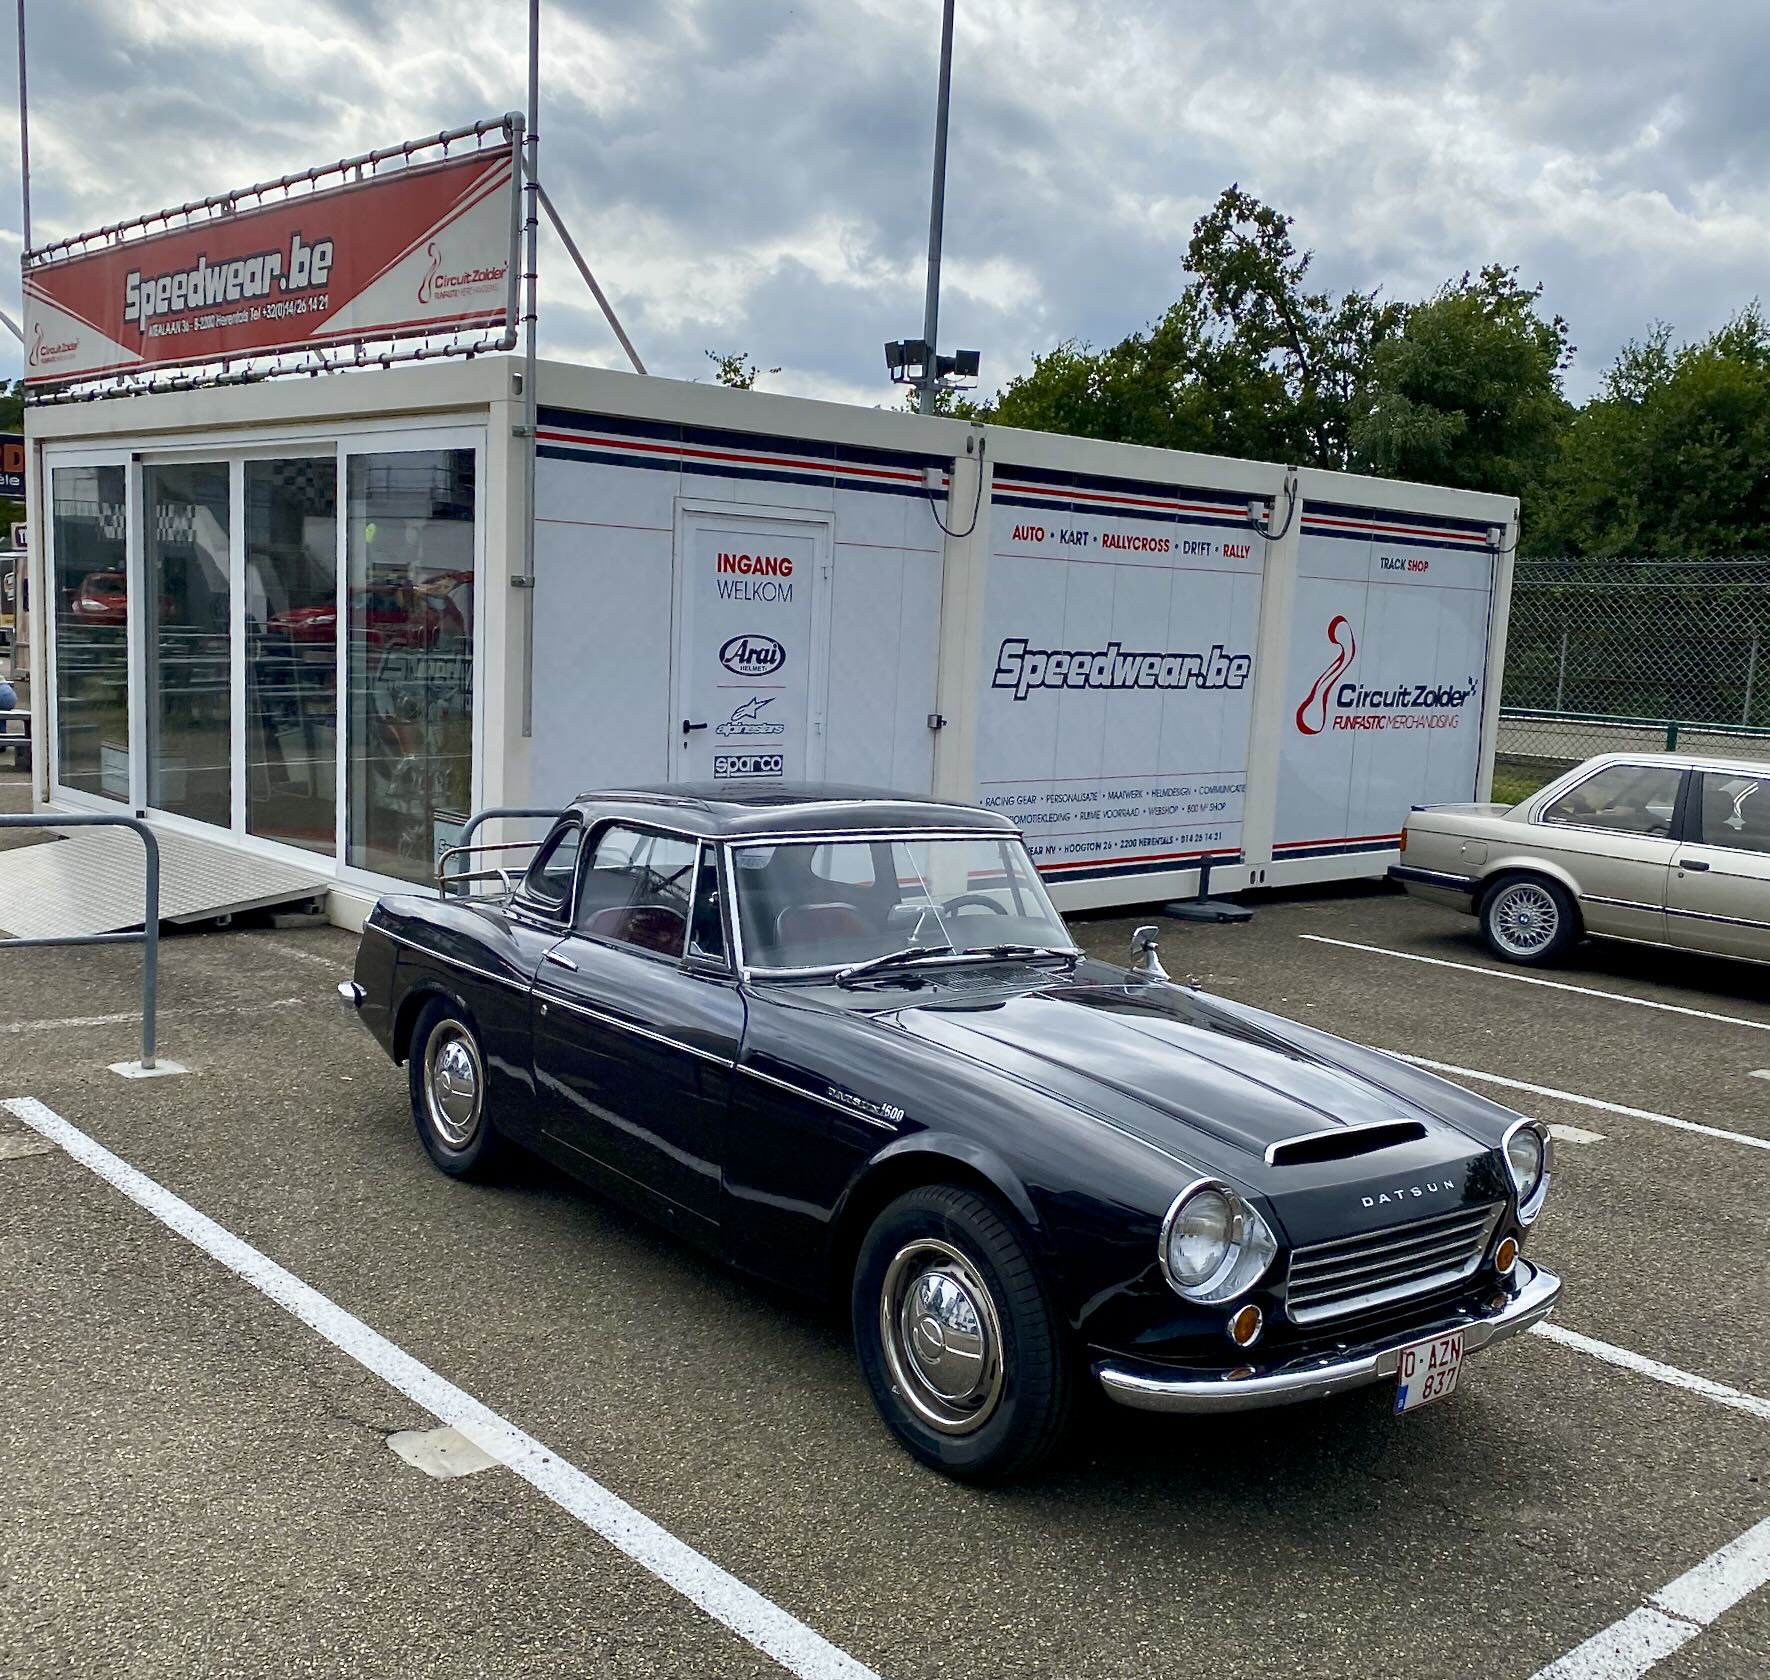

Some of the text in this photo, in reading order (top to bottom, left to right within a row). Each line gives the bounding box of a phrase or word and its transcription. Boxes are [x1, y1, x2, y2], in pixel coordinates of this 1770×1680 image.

[124, 231, 334, 334] Speedwear.be
[249, 306, 261, 321] Tel
[308, 297, 318, 312] 14
[319, 294, 329, 310] 21
[1012, 525, 1251, 559] AUTO KART RALLYCROSS DRIFT RALLY
[717, 553, 793, 577] INGANG
[1381, 557, 1429, 572] TRACK SHOP
[717, 579, 793, 602] WELKOM
[723, 638, 779, 665] Arai
[992, 638, 1251, 701] Speedwear.be
[715, 721, 785, 737] alpinestars
[1333, 714, 1460, 730] FUNFASTIC MERCHANDISING
[715, 756, 782, 778] sparco
[985, 796, 1015, 807] RACING
[1017, 794, 1037, 805] GEAR
[1108, 788, 1143, 800] MAATWERK
[1151, 787, 1191, 798] HELMDESIGN
[1080, 810, 1101, 821] RUIME
[1102, 807, 1139, 819] VOORRAAD
[1148, 805, 1178, 816] WEBSHOP
[1209, 801, 1227, 812] SHOP
[1045, 845, 1056, 855] NV
[1064, 842, 1102, 854] HOOGTON
[1103, 842, 1112, 850] 26
[1120, 838, 1137, 848] 2200
[1138, 835, 1174, 847] HERENTALS
[880, 1102, 905, 1122] 1600
[1361, 1180, 1455, 1208] DATSUN
[1422, 1366, 1457, 1400] 837
